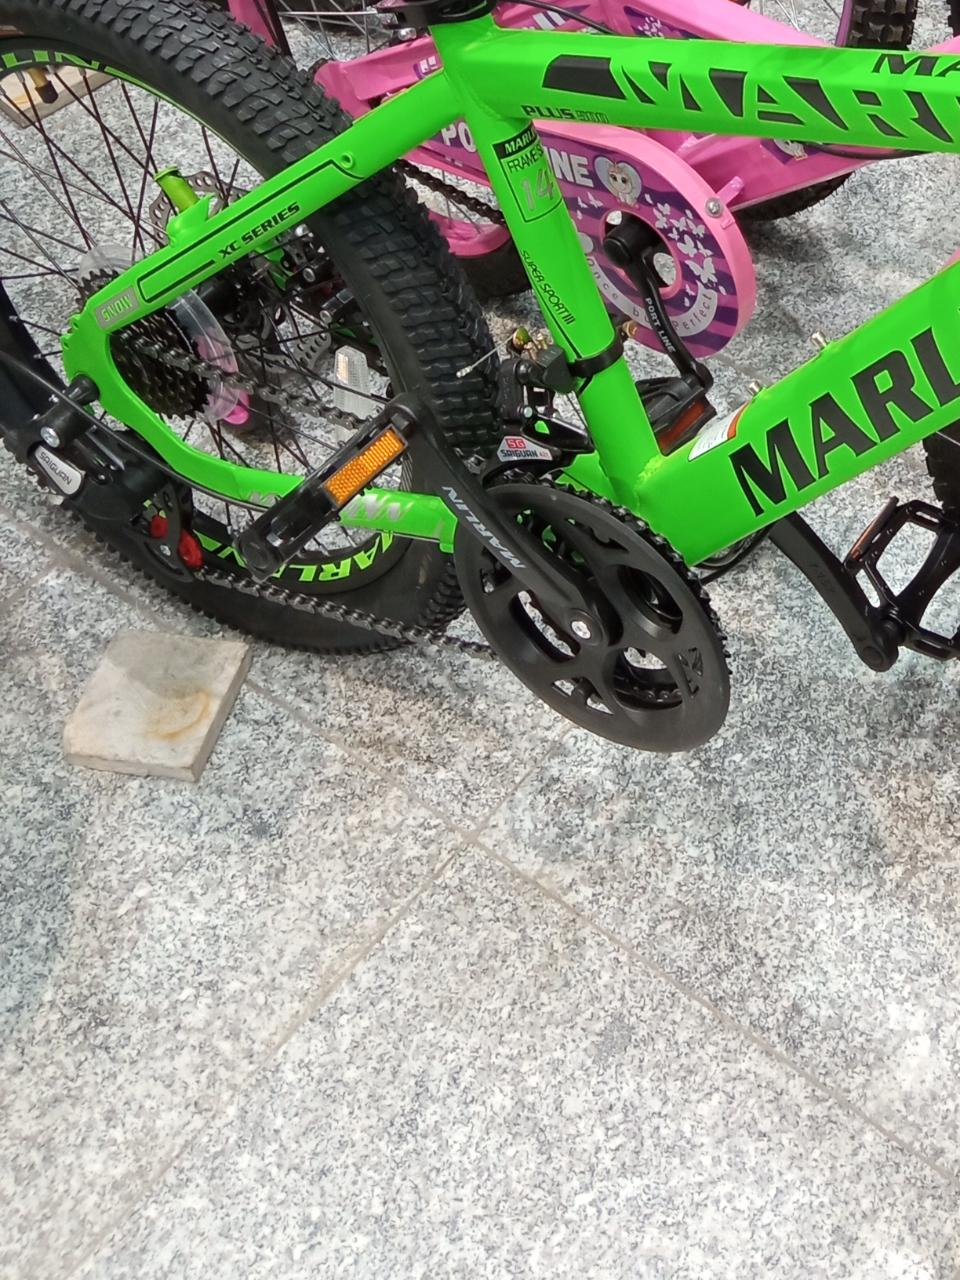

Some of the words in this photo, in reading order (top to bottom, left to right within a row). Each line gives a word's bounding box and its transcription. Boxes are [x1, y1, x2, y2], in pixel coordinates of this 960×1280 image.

[522, 104, 575, 119] PLUS
[441, 122, 477, 153] PO
[543, 145, 595, 188] INE
[503, 127, 536, 154] MARLI
[521, 168, 554, 211] 14
[218, 239, 243, 259] XC
[240, 201, 301, 244] SERIES
[520, 249, 545, 285] SUPER
[645, 297, 662, 326] PORT
[657, 325, 677, 354] LINE
[39, 451, 73, 486] SAIGUAN
[442, 486, 527, 569] MARLIN
